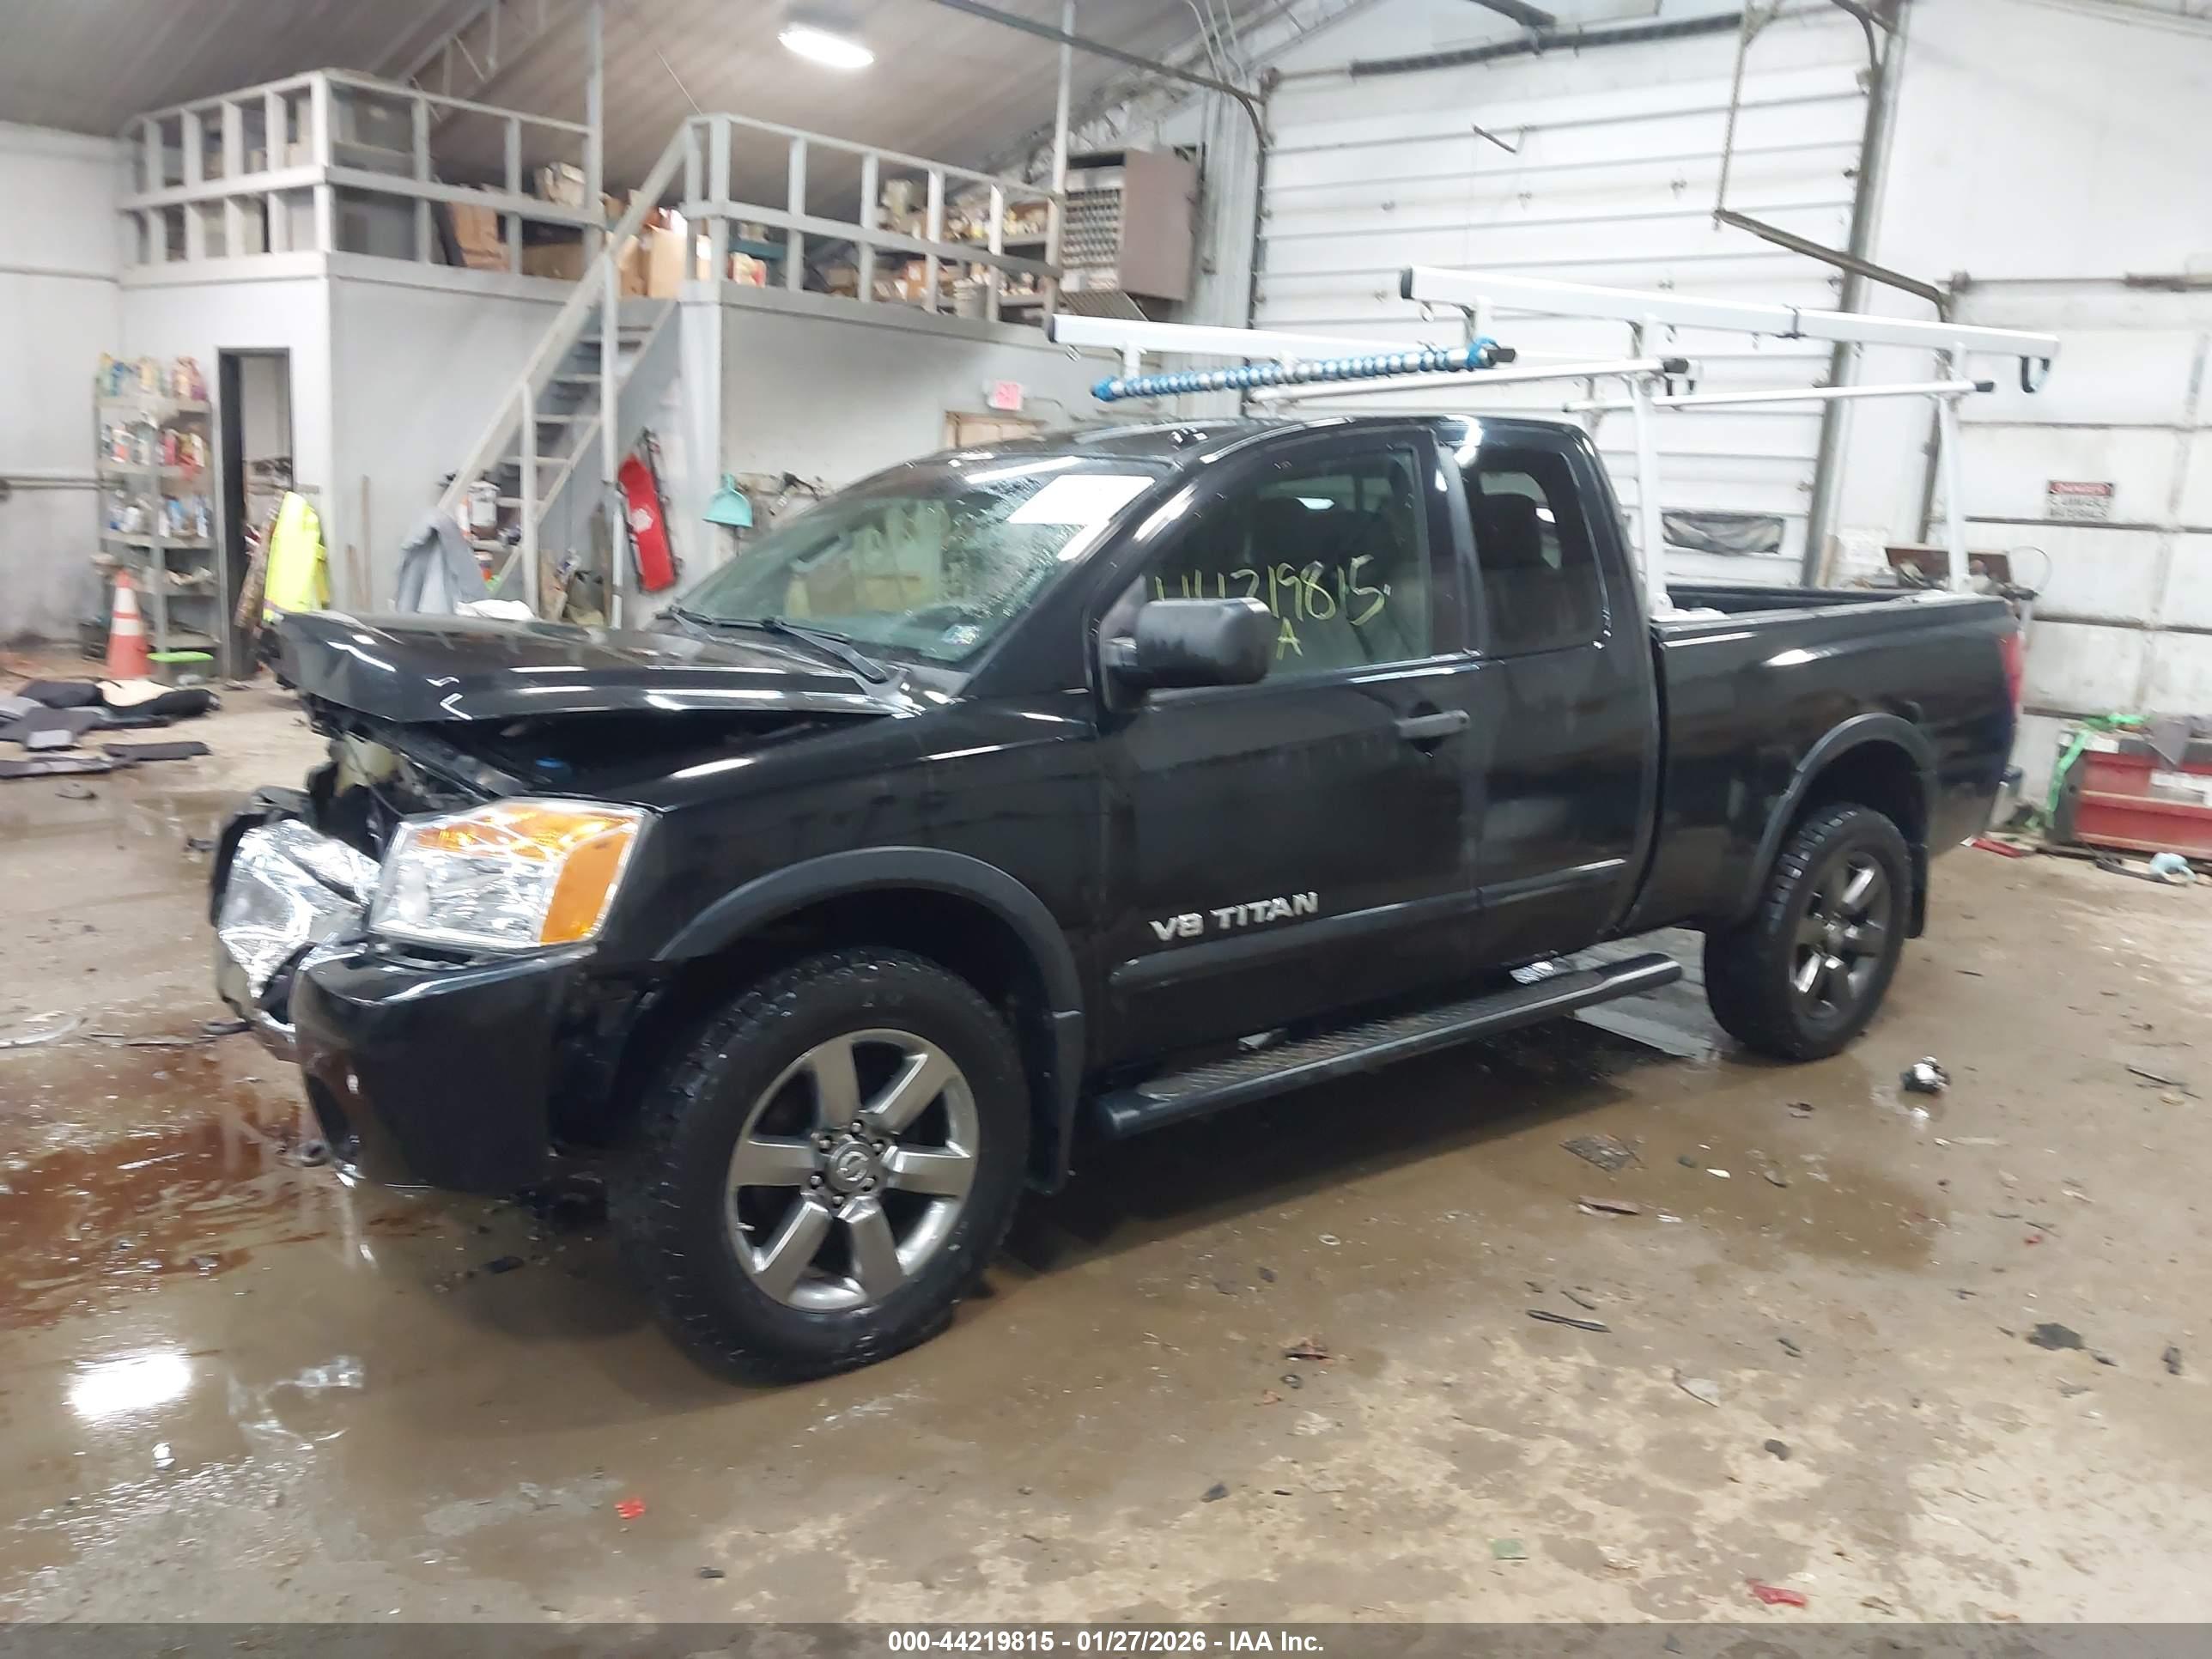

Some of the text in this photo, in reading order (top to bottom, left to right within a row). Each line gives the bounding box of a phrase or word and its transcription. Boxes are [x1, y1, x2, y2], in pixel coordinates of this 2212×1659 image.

[1276, 616, 1304, 660] A
[1148, 890, 1319, 942] V8 TITAN
